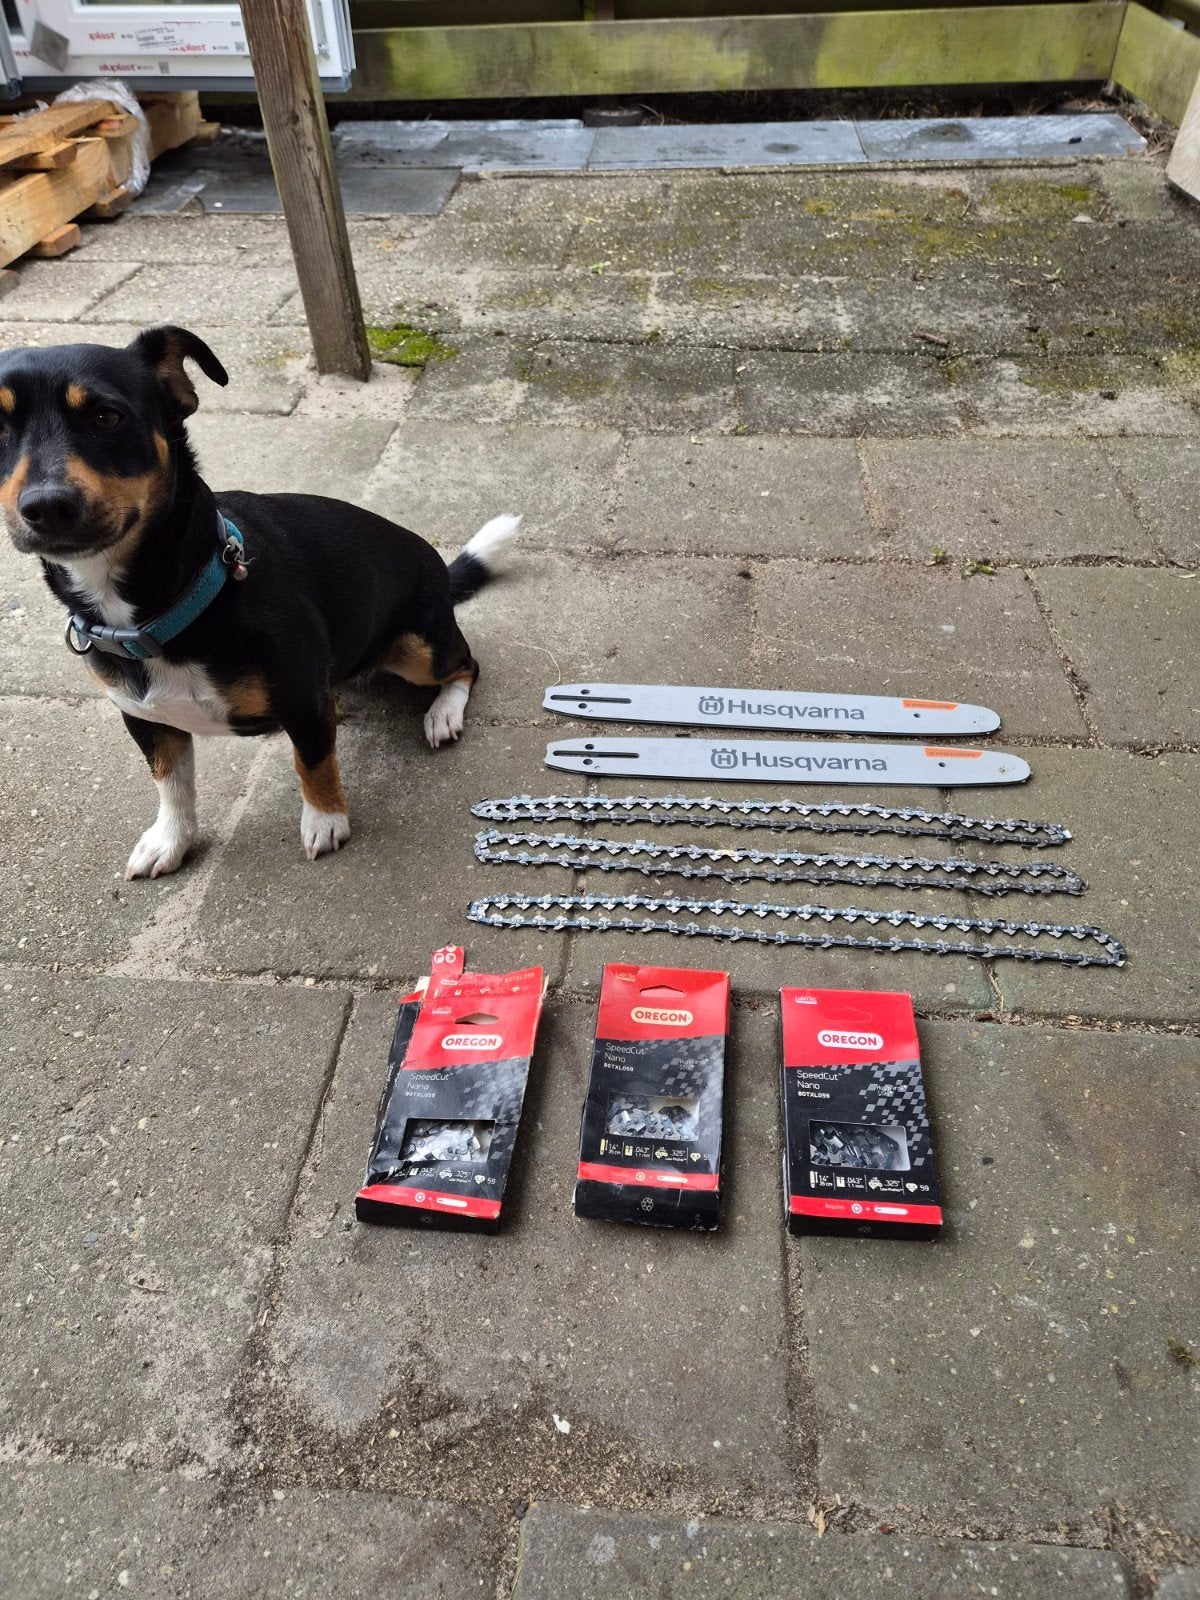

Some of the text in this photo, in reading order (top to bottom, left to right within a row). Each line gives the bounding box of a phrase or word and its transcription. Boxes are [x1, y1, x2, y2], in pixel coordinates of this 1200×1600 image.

[728, 700, 865, 720] Husqvarna
[742, 752, 887, 772] Husqvarna
[635, 1011, 688, 1022] OREGON
[445, 1037, 497, 1047] OREGON
[822, 1034, 877, 1046] OREGON
[604, 1053, 626, 1063] Nano
[406, 1082, 429, 1090] Nano
[797, 1081, 820, 1089] Nano
